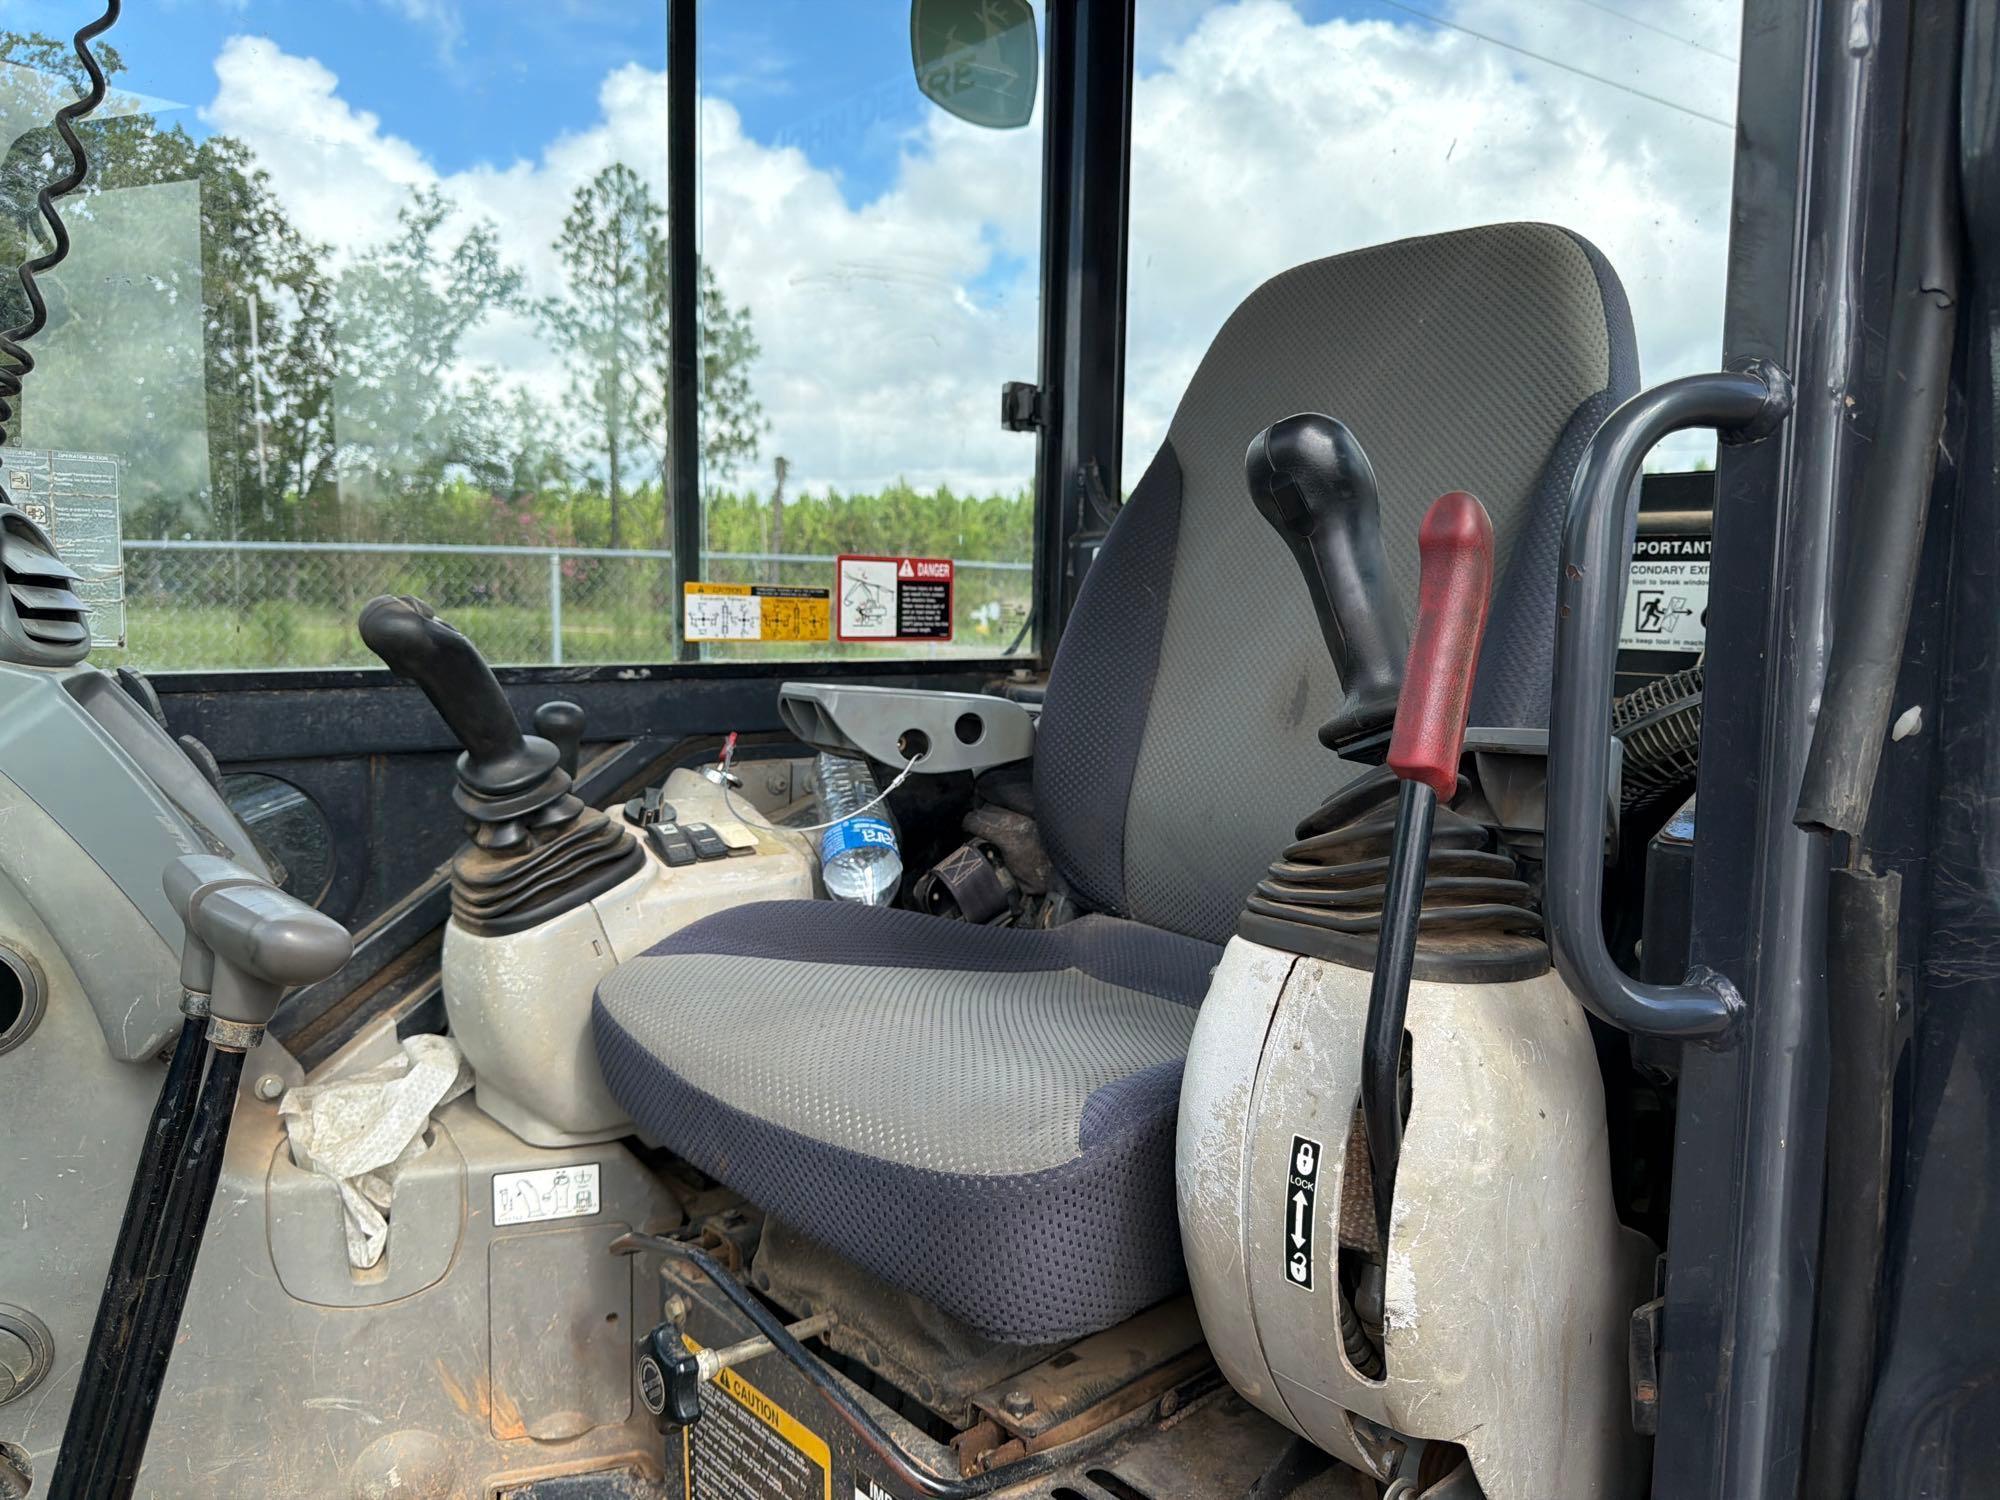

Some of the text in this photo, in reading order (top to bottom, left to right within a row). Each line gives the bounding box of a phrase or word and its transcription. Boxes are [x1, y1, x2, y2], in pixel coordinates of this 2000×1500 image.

[1632, 541, 1711, 555] PORTANT
[917, 562, 950, 577] DANGER
[1290, 1174, 1314, 1191] LOCK
[733, 1380, 779, 1428] CAUTION
